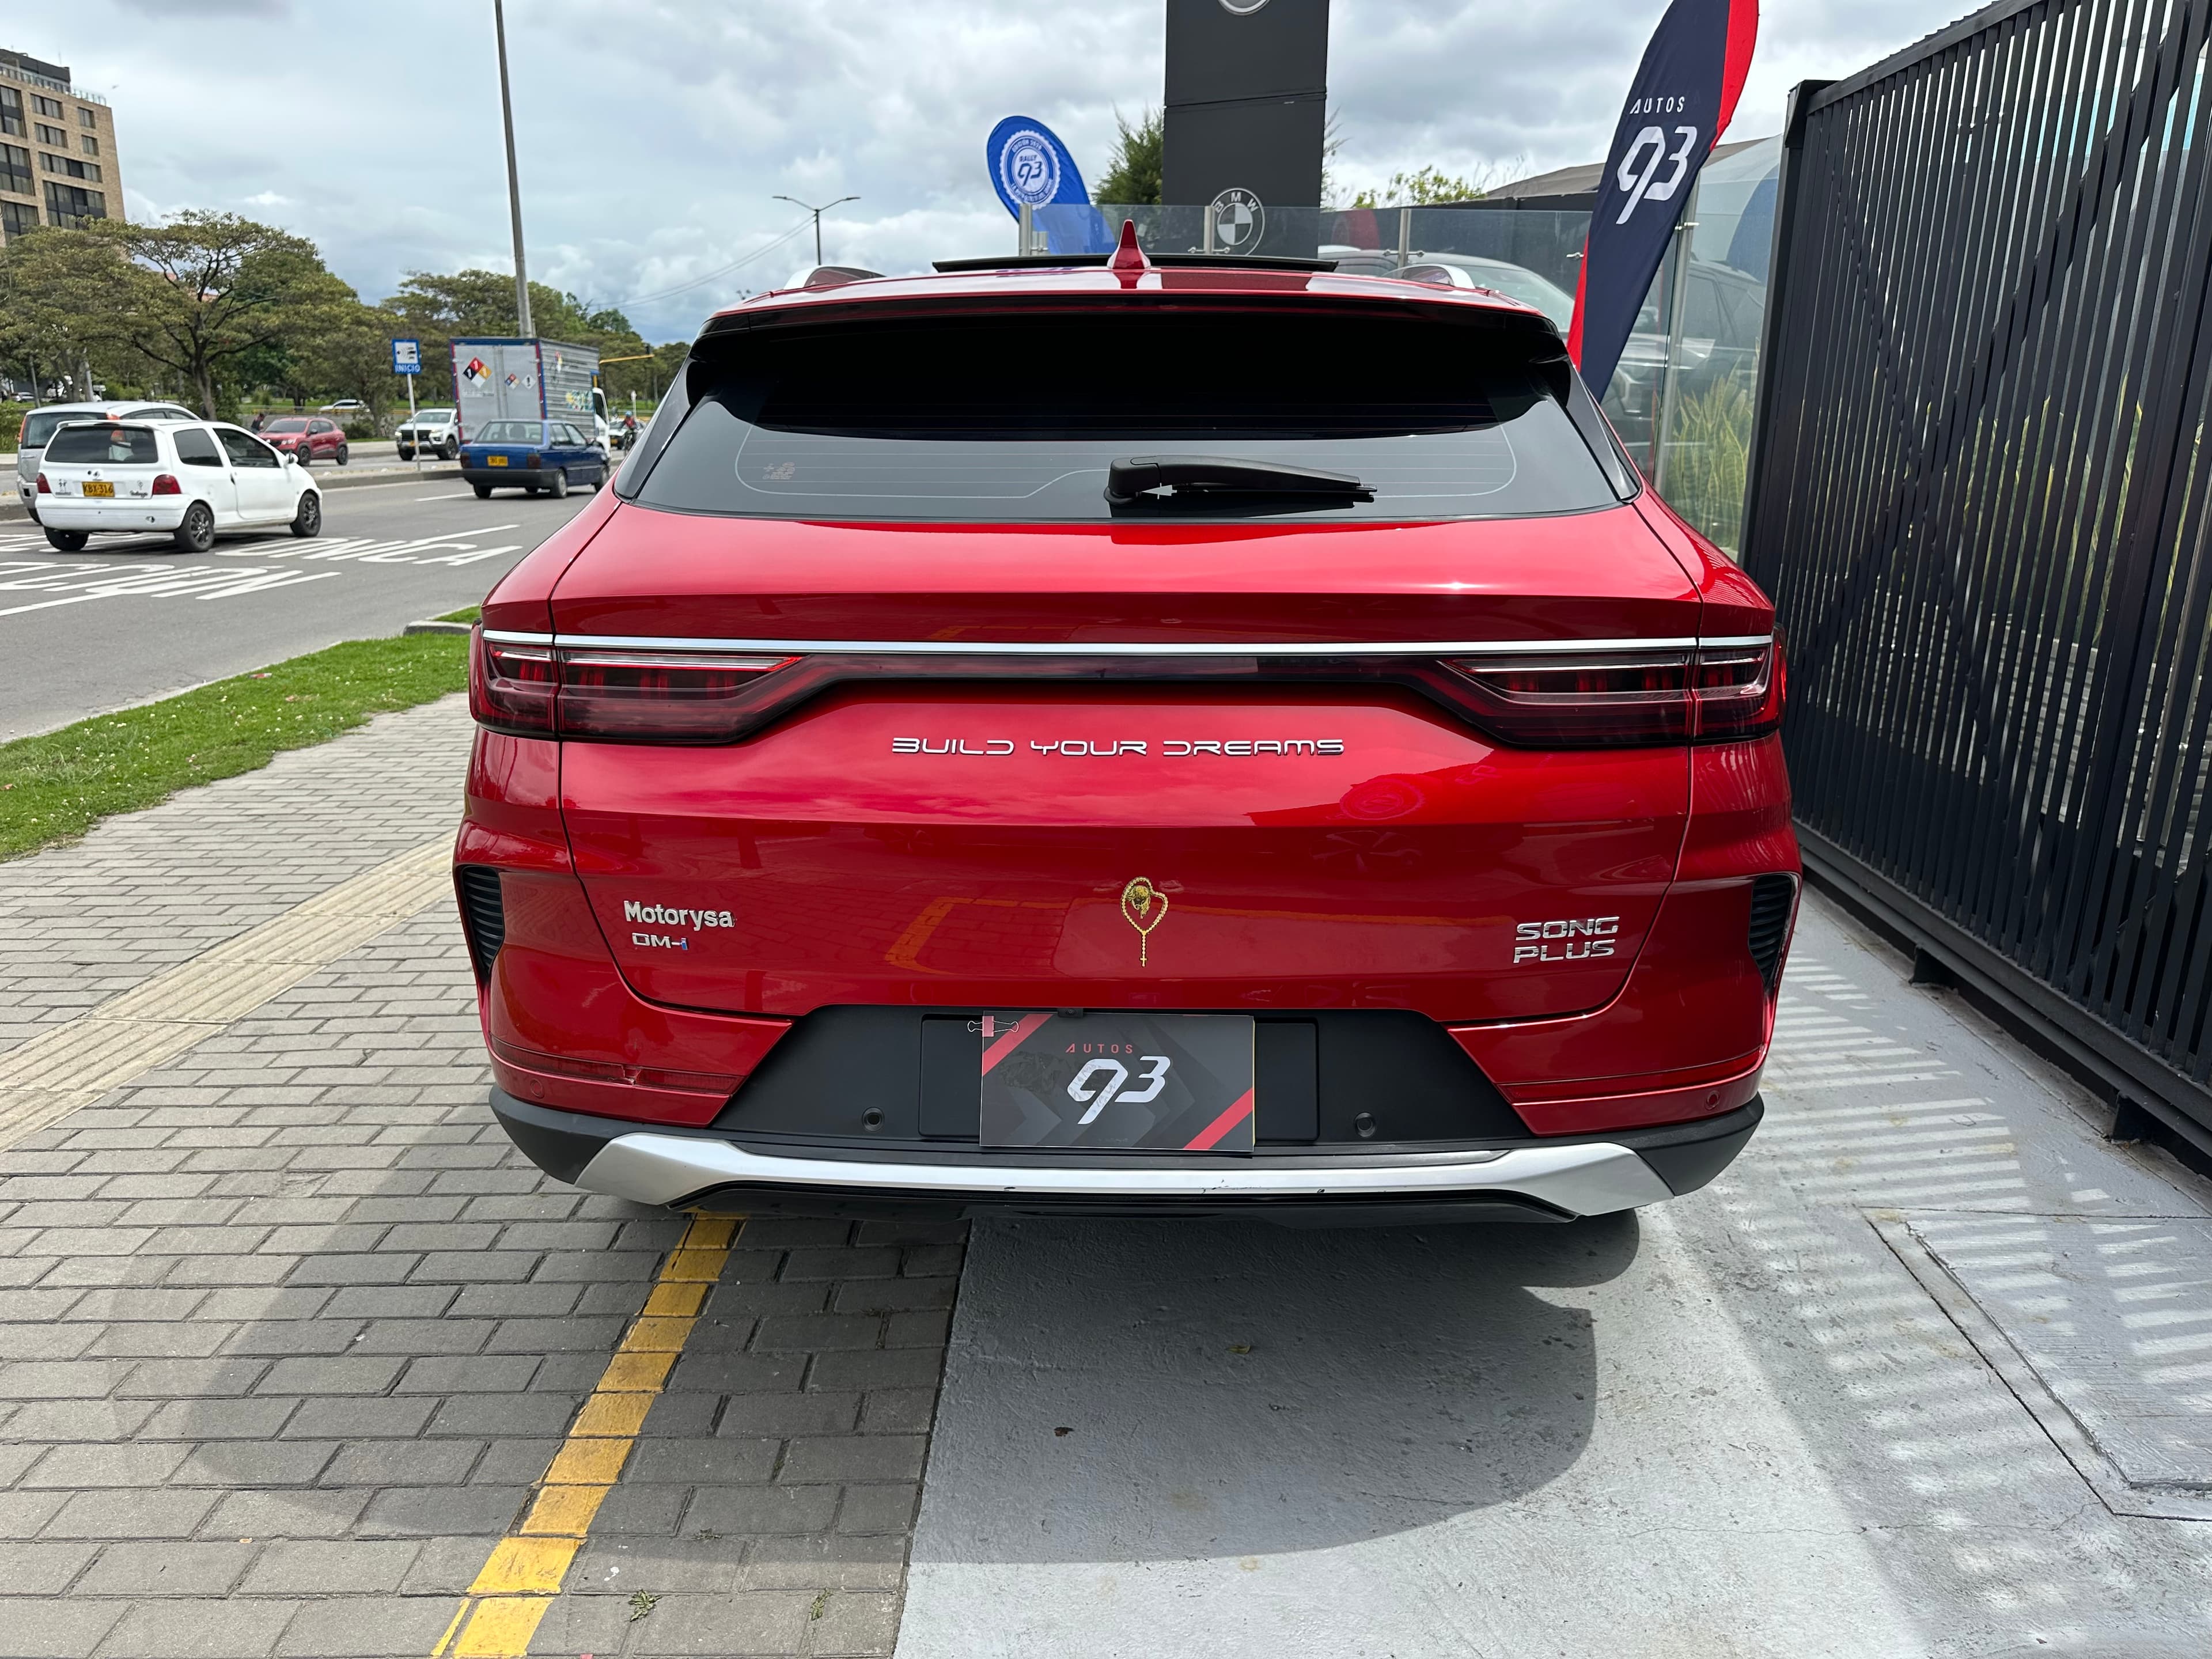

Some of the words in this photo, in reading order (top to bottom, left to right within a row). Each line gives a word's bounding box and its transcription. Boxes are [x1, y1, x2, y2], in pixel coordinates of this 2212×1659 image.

[1629, 96, 1685, 114] AUTOS
[1017, 161, 1043, 187] 93
[1615, 126, 1698, 225] 93
[1214, 191, 1259, 214] BMW
[395, 363, 421, 373] INICIO
[892, 737, 1014, 755] BUILD
[1031, 739, 1147, 756] YOUR
[1162, 738, 1345, 756] DREAMS
[623, 900, 736, 931] Motorysa
[1515, 916, 1620, 941] SONG
[1513, 939, 1616, 964] PLUS
[1065, 1043, 1134, 1054] AUTOS
[1067, 1055, 1171, 1125] 93
